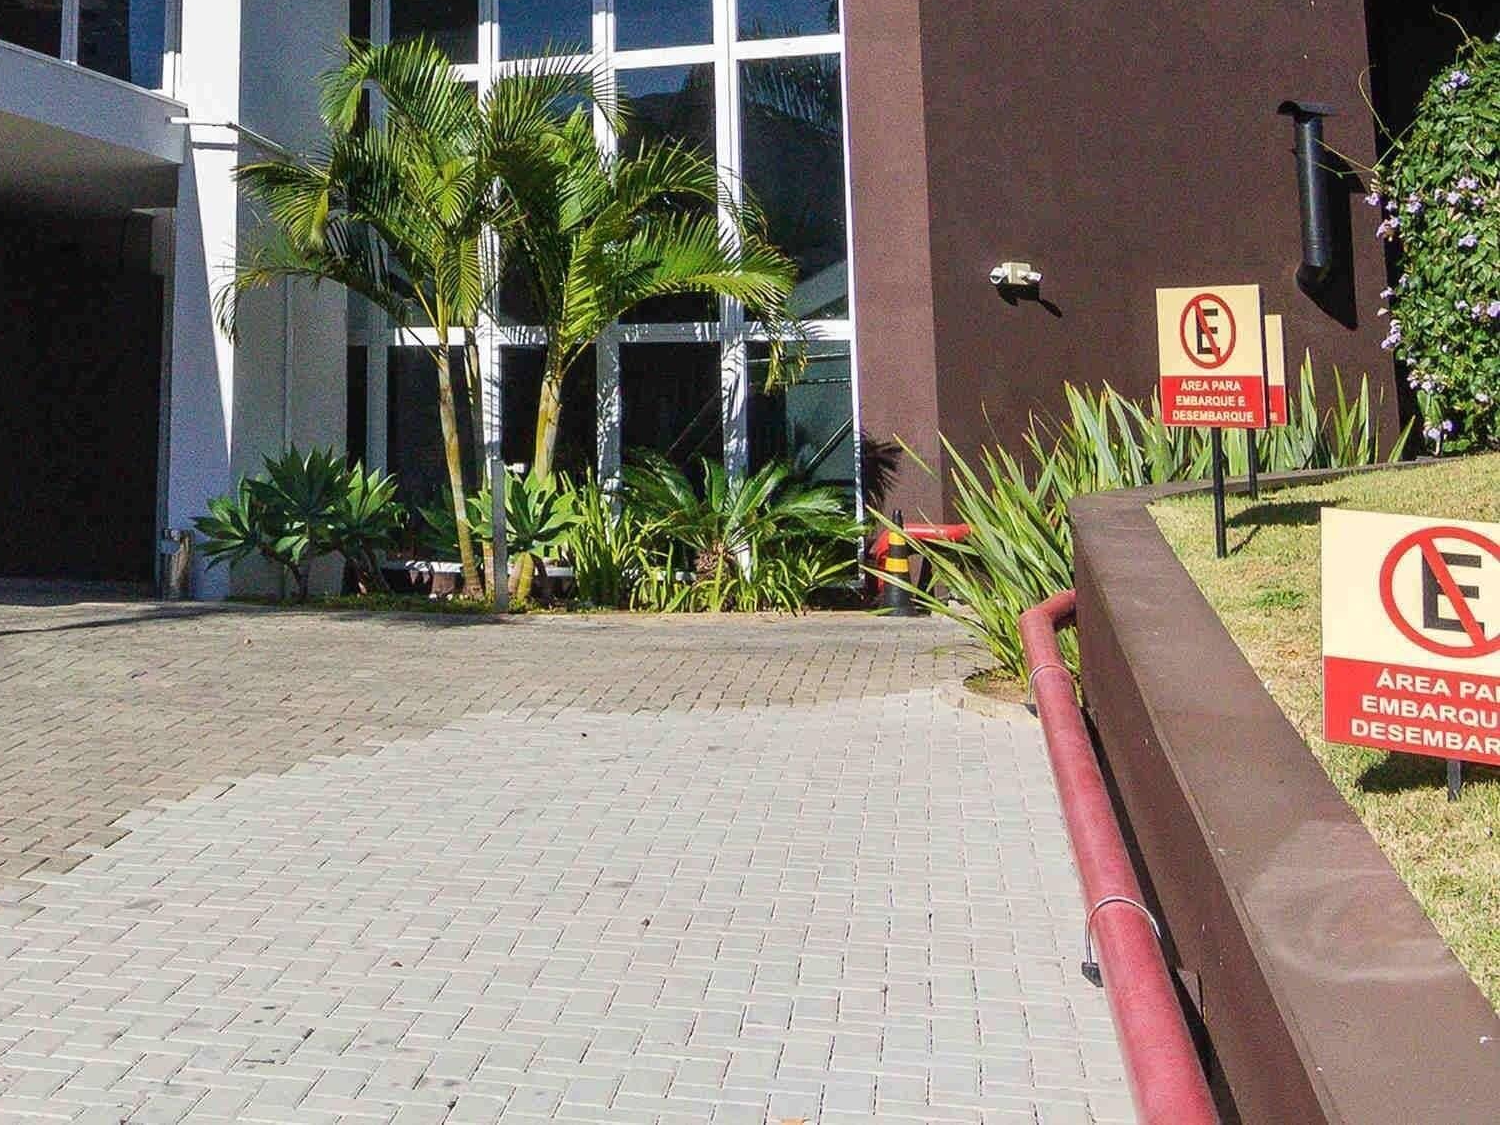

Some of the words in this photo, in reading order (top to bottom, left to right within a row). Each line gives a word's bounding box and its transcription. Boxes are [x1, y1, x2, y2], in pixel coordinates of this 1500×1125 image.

[1180, 378, 1210, 391] ÁREA
[1211, 380, 1241, 391] PARA
[1175, 395, 1236, 407] EMBARQUE
[1238, 396, 1246, 407] E
[1172, 410, 1254, 422] DESEMBARQUE
[1376, 668, 1452, 697] ÁREA
[1459, 681, 1500, 704] PA
[1361, 694, 1498, 729] EMBARQU
